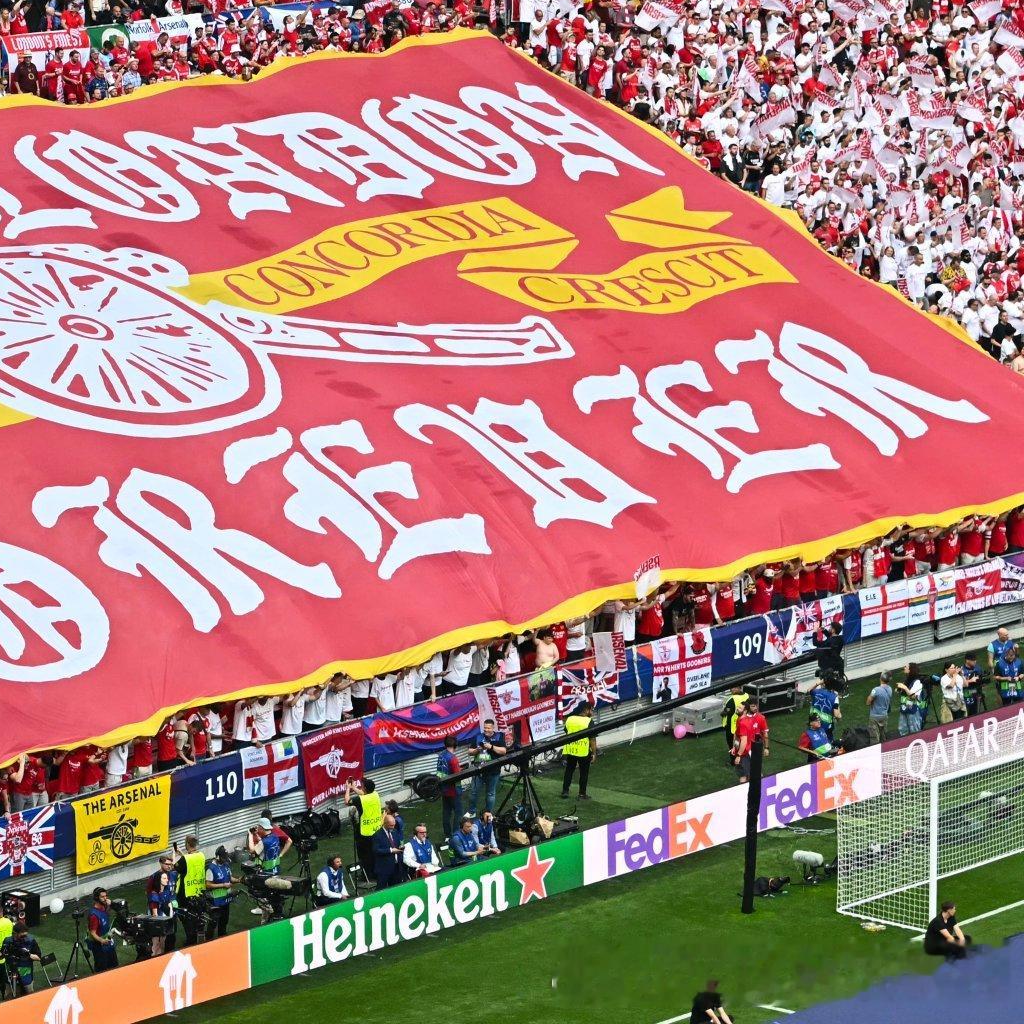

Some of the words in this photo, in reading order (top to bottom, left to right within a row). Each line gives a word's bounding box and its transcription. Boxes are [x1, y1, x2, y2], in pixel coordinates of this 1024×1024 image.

[223, 208, 543, 306] CONCORDIA
[518, 247, 765, 307] CRESCIT
[687, 657, 711, 668] GOONERS
[733, 632, 761, 660] 109
[393, 726, 432, 739] Arsenal
[905, 715, 1004, 778] QATAR
[83, 798, 106, 816] THE
[108, 783, 162, 811] ARSENAL
[205, 771, 238, 801] 110
[756, 759, 859, 829] FedEx
[607, 800, 714, 875] FedEx
[290, 869, 508, 976] Heineken
